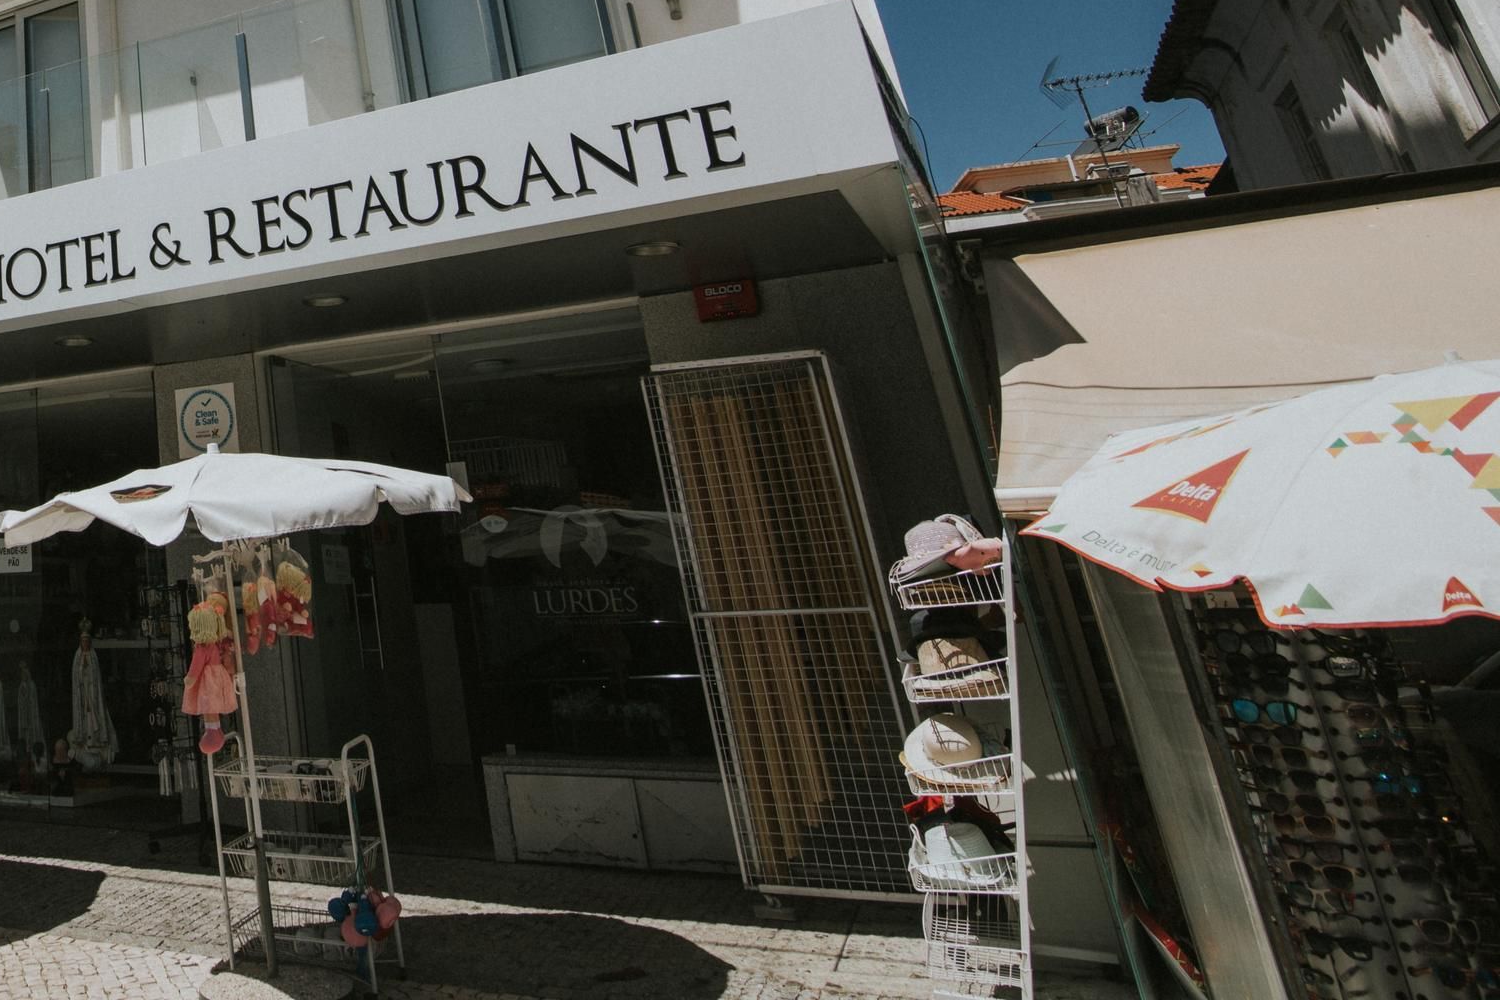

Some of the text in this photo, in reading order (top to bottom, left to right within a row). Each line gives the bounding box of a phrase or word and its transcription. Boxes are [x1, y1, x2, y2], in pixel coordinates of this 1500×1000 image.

[149, 222, 191, 268] &
[203, 100, 746, 266] RESTAURANTE
[704, 284, 742, 296] BLOCO
[195, 410, 217, 418] Clean
[1168, 480, 1217, 501] Delta
[1082, 530, 1127, 554] Delta
[0, 546, 28, 555] VENDE-SE
[8, 557, 20, 567] PÃO
[533, 586, 638, 614] LURDES
[1445, 592, 1472, 601] Delta
